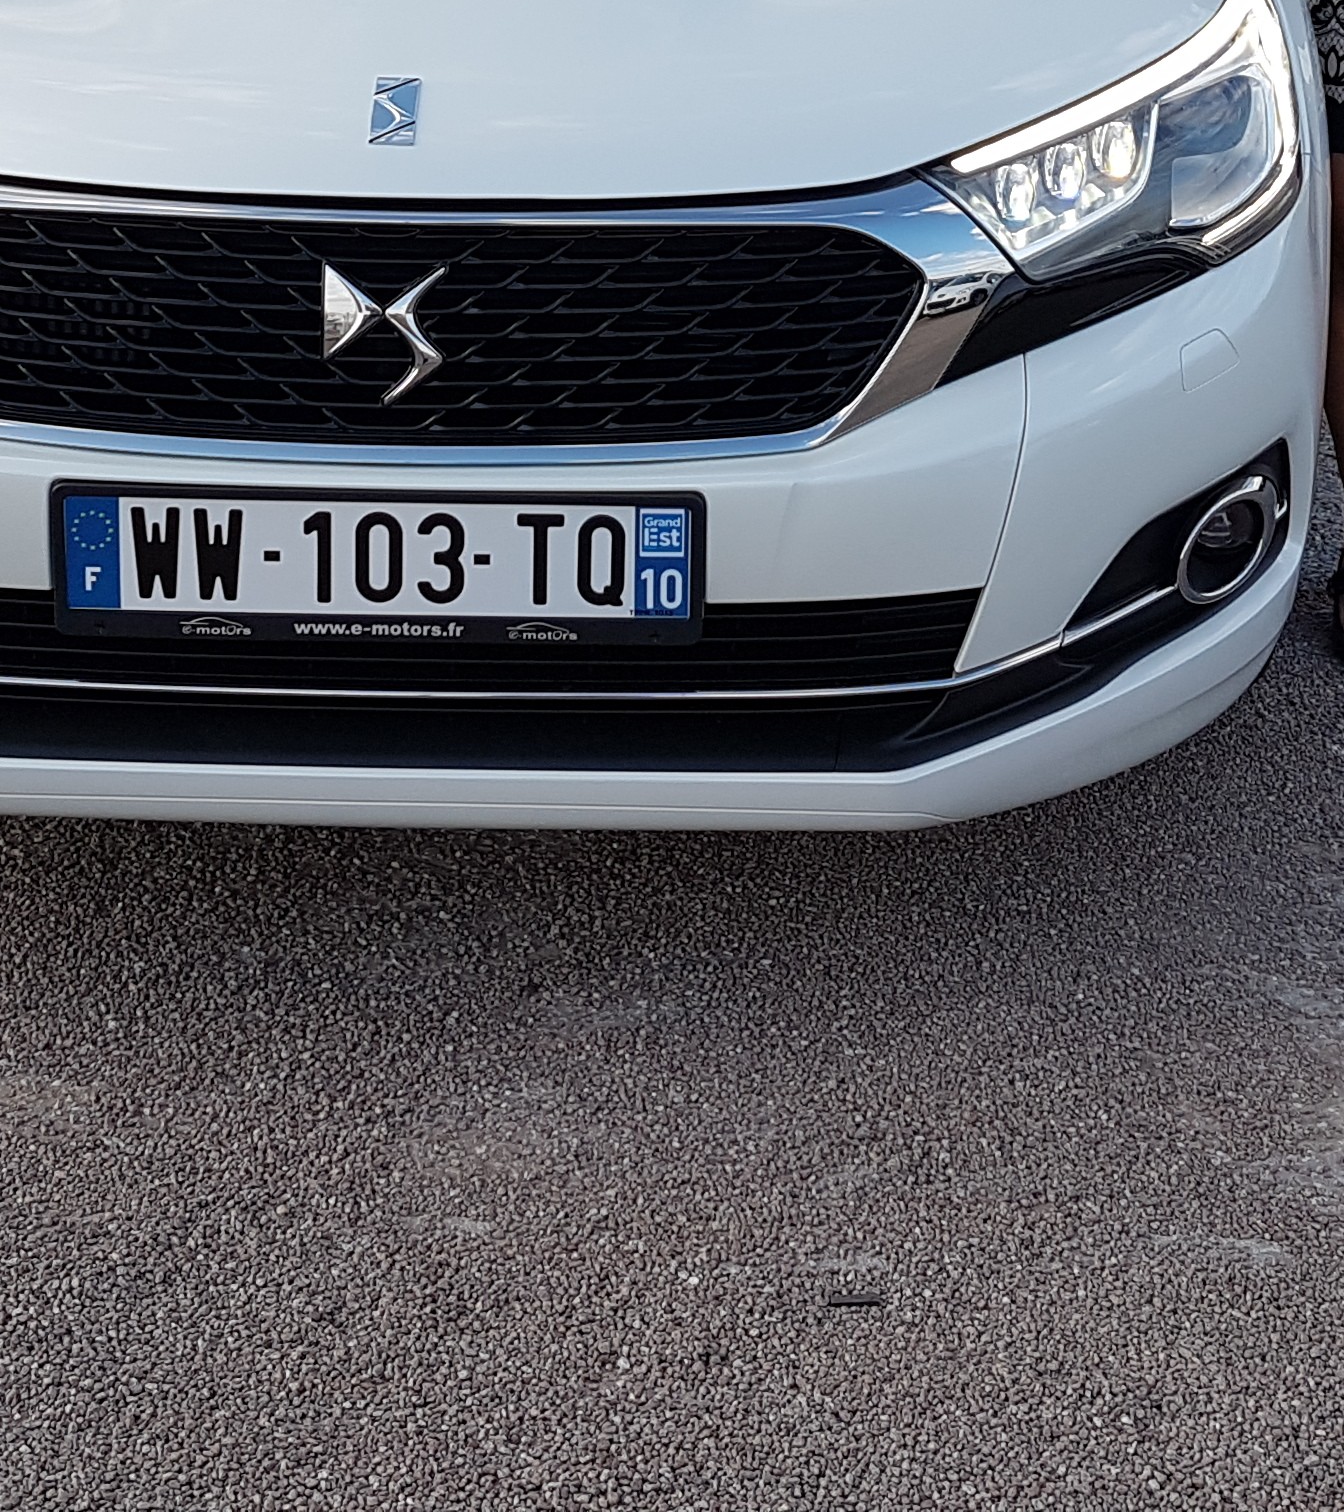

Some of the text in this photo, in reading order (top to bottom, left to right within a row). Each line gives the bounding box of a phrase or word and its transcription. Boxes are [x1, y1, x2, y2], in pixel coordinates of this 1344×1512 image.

[644, 517, 681, 527] Grand
[644, 528, 680, 547] Est
[85, 567, 101, 591] F
[641, 568, 683, 609] 10
[294, 622, 464, 637] www.e-motors.fr
